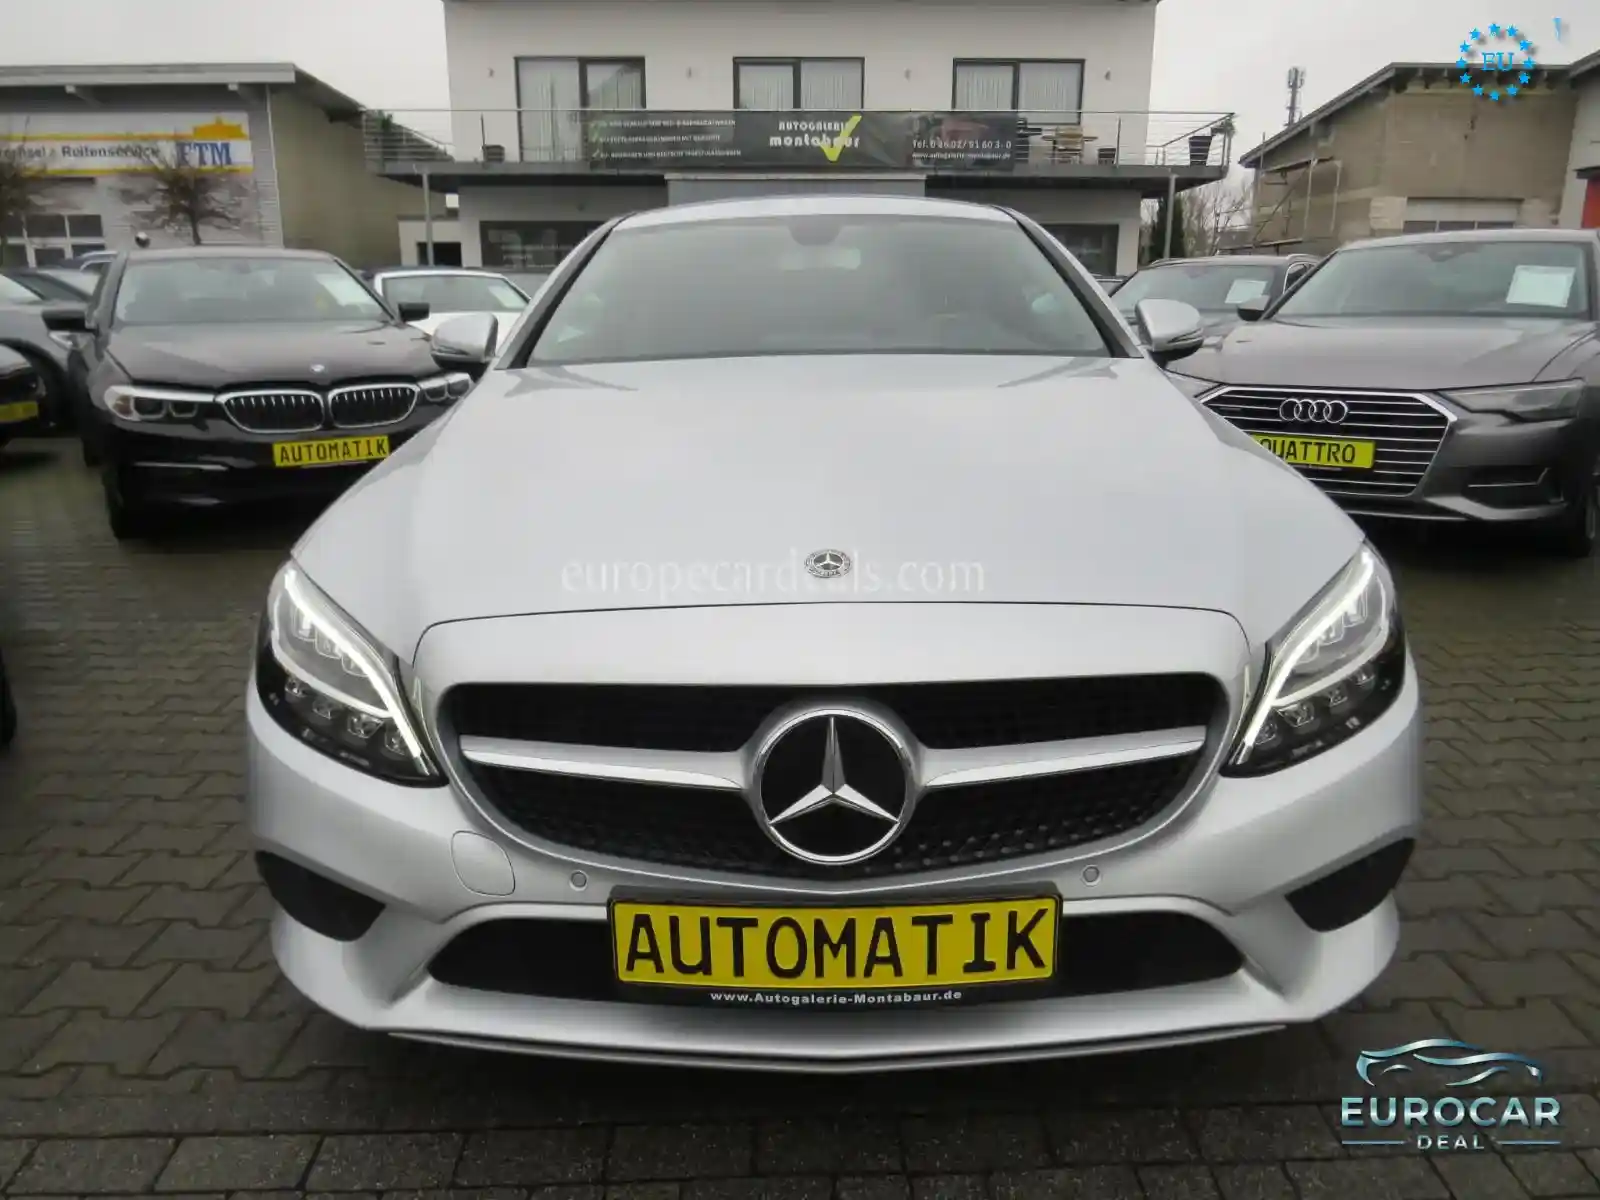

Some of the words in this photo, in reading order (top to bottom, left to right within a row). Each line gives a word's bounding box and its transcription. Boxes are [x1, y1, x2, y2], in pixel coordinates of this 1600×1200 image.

[779, 121, 851, 131] AUTOGALERI
[280, 438, 386, 463] AUTOMATIK
[625, 908, 1048, 979] AUTOMATIK
[710, 989, 962, 1006] www.Autogalerie-Montabaur.de
